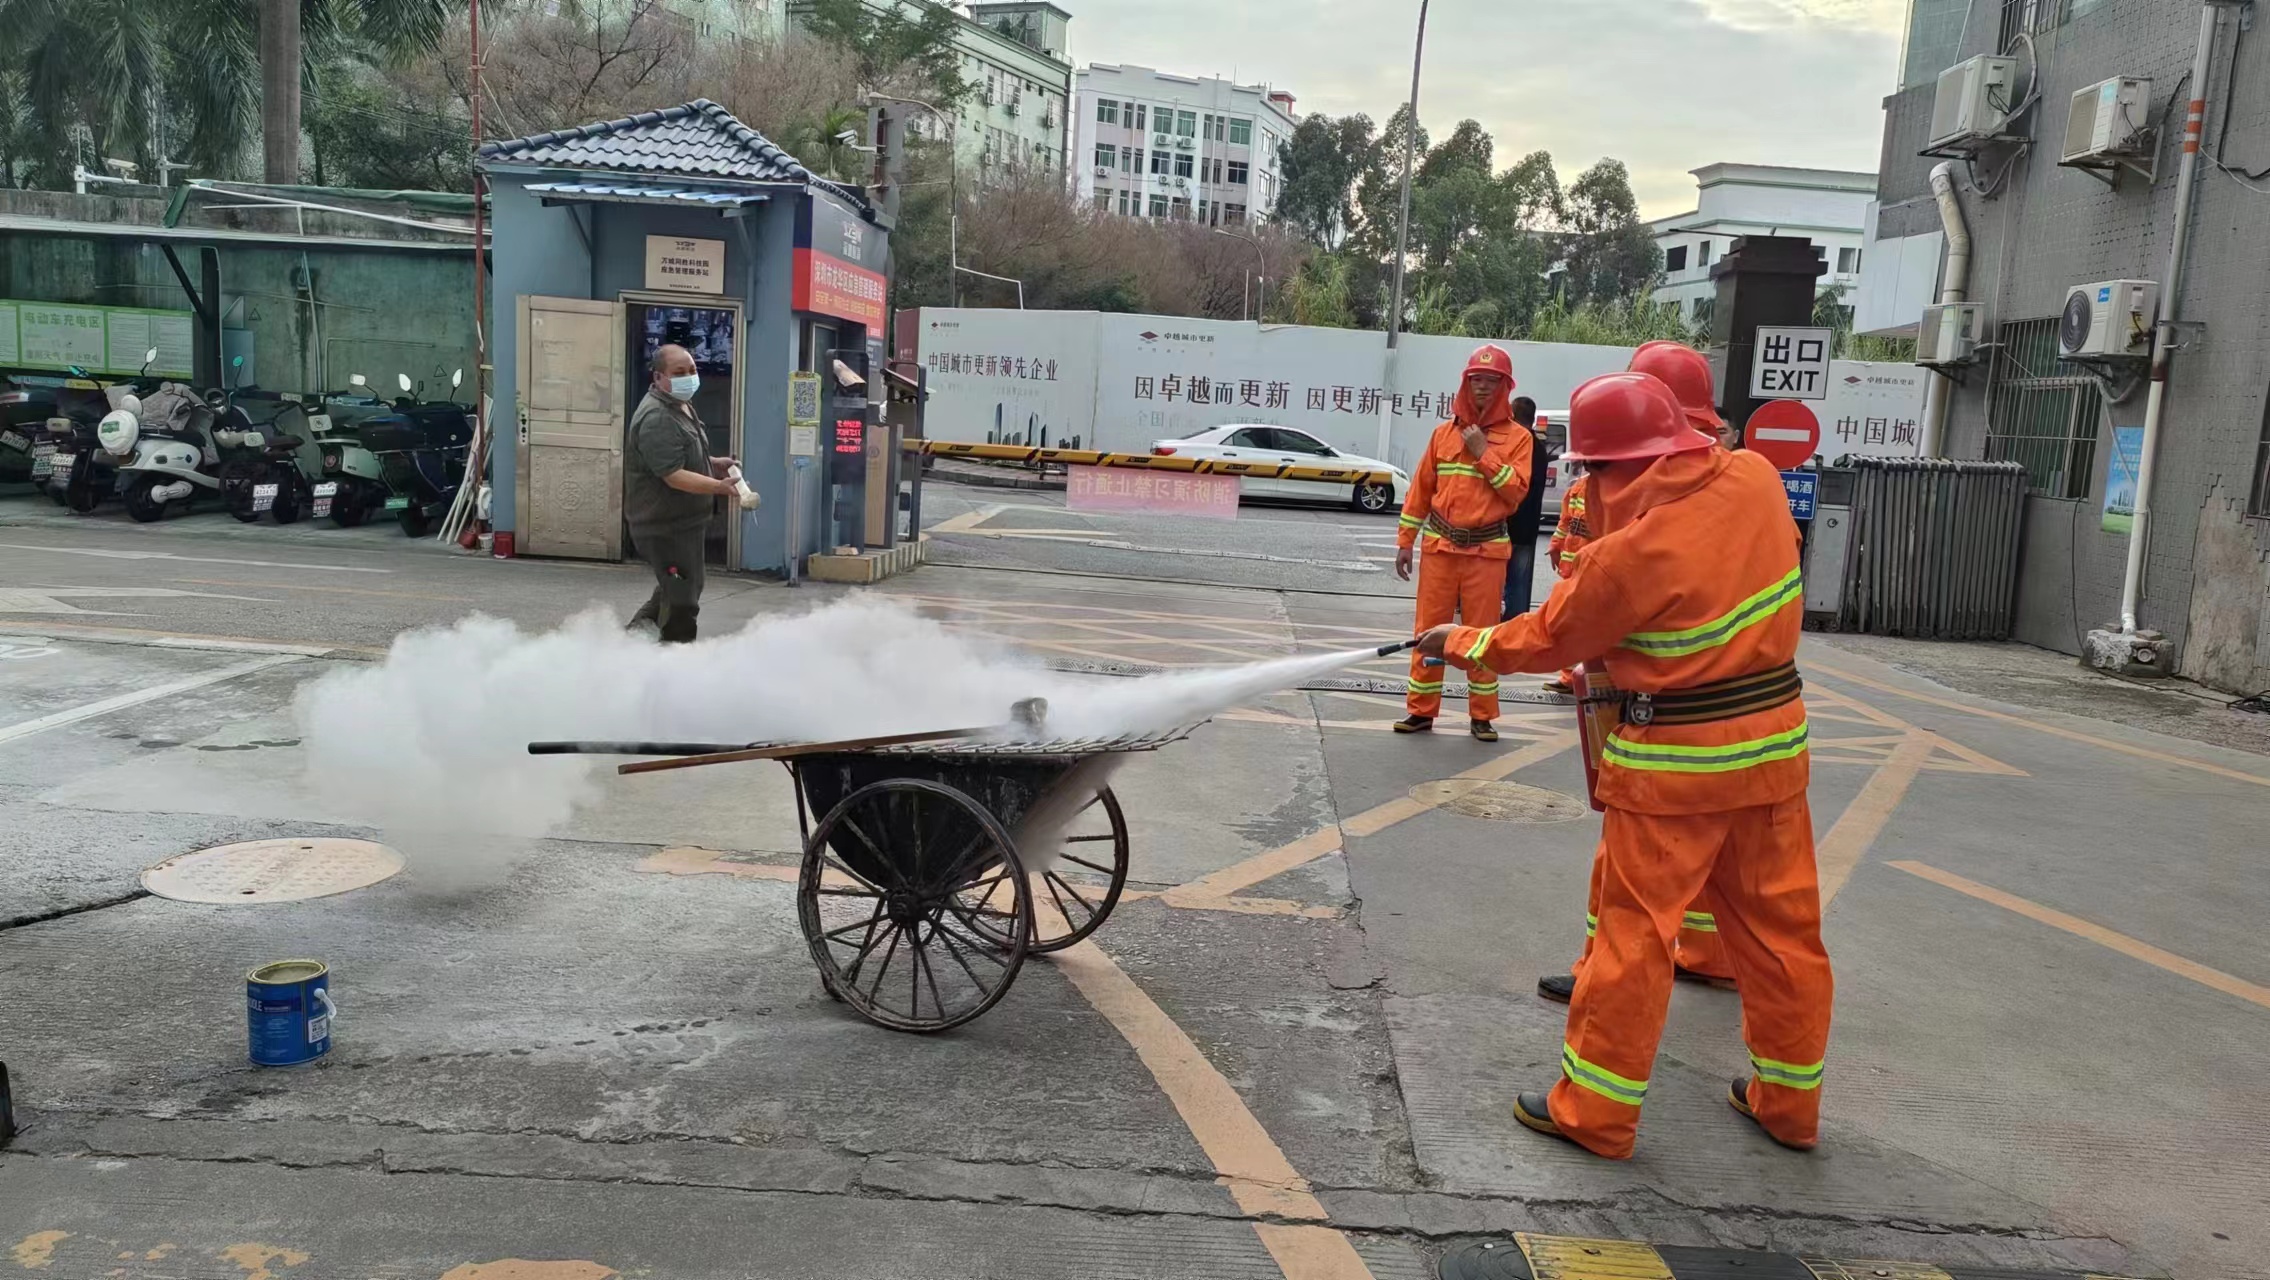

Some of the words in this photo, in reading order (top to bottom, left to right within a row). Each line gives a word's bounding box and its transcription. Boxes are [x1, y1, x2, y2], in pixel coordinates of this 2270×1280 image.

[814, 260, 883, 303] 深圳市龙华区应急管理服务站
[24, 311, 100, 329] 电动车充电区
[1762, 335, 1823, 365] 出口
[928, 351, 1058, 381] 中国城市更新领先企业
[1761, 369, 1819, 391] EXIT
[1134, 373, 1290, 410] 因卓越而更新
[1836, 416, 1916, 447] 中国城
